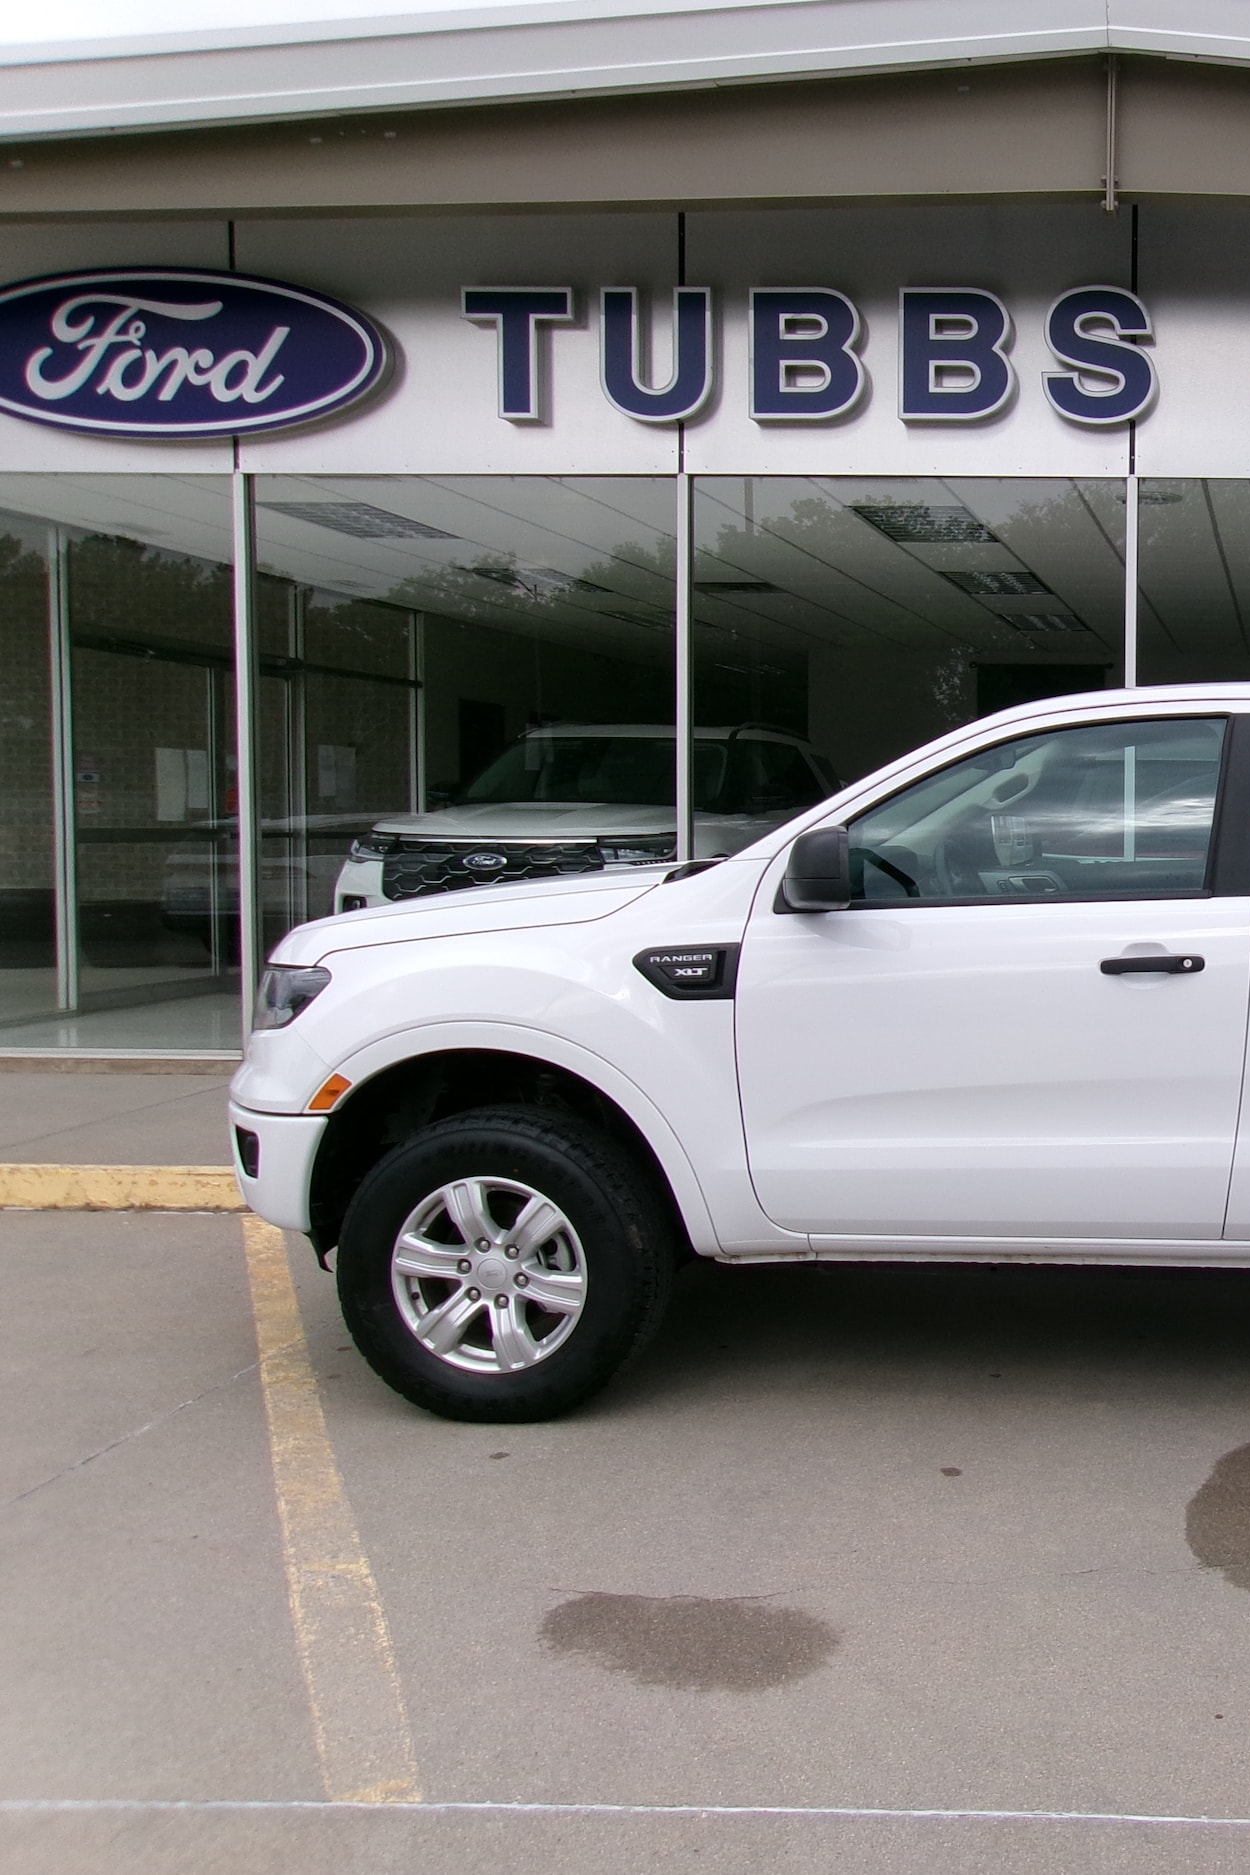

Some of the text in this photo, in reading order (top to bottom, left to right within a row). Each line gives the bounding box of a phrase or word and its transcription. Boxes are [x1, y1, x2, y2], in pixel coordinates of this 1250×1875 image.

[25, 293, 289, 404] Ford
[460, 285, 1160, 424] TUBBS
[650, 954, 713, 963] RANGER
[674, 967, 708, 976] XLT
